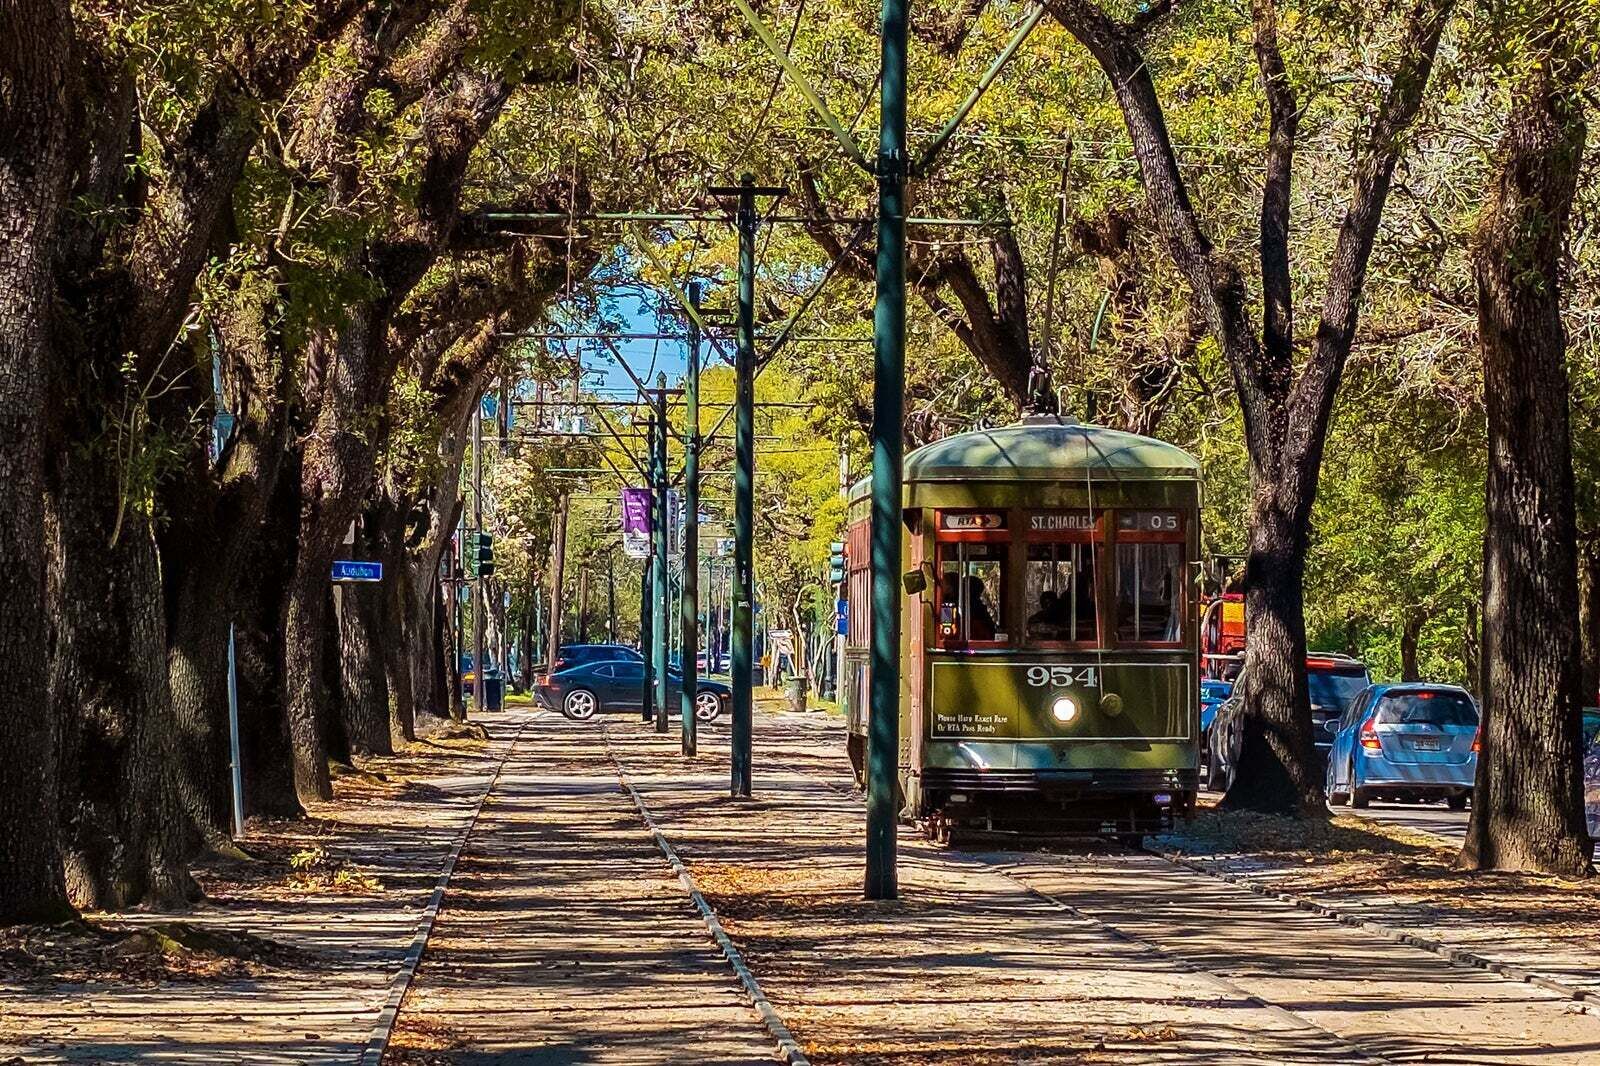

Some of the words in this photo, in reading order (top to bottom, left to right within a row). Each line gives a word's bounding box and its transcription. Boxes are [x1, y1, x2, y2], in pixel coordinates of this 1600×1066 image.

[1031, 515, 1046, 529] ST.
[1027, 666, 1098, 687] 954
[937, 713, 956, 722] Please
[974, 714, 992, 723] Exact
[947, 723, 960, 732] RTA
[976, 724, 996, 733] Ready
